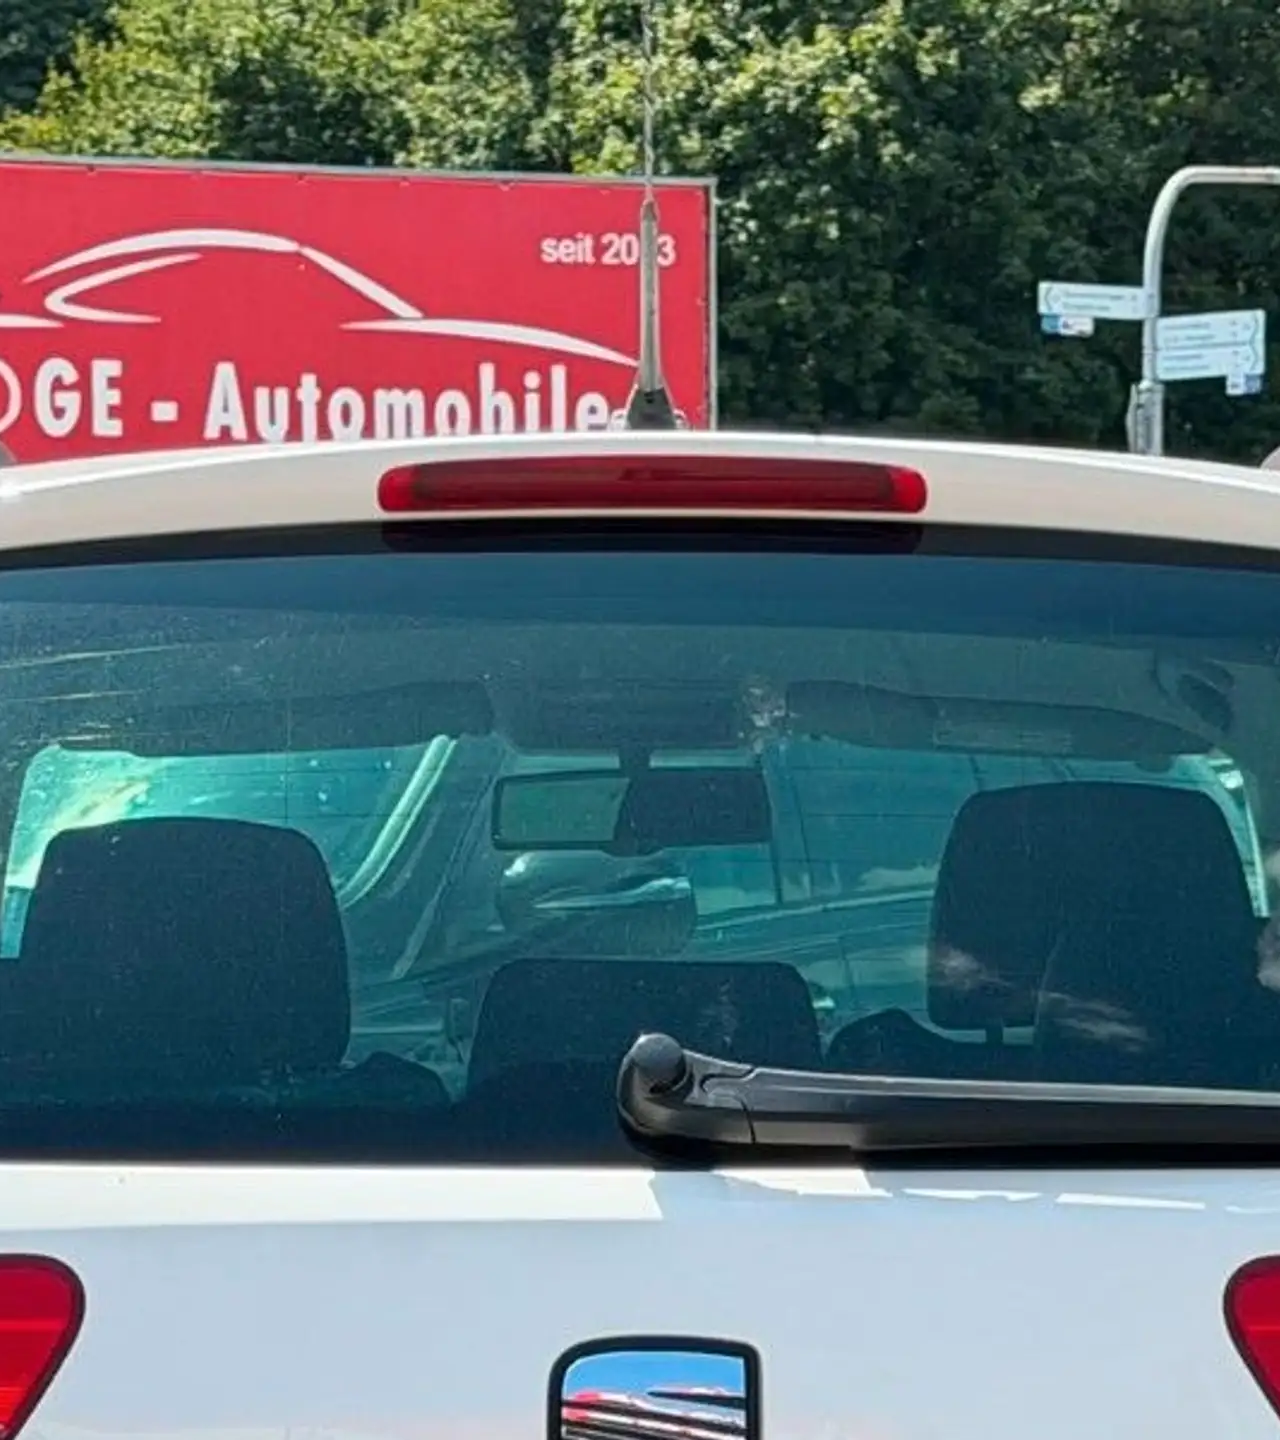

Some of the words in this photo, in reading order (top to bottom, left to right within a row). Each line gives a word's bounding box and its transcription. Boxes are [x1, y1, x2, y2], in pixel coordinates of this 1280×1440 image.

[540, 232, 596, 264] seit
[600, 232, 677, 267] 203
[204, 361, 609, 443] Automobile
